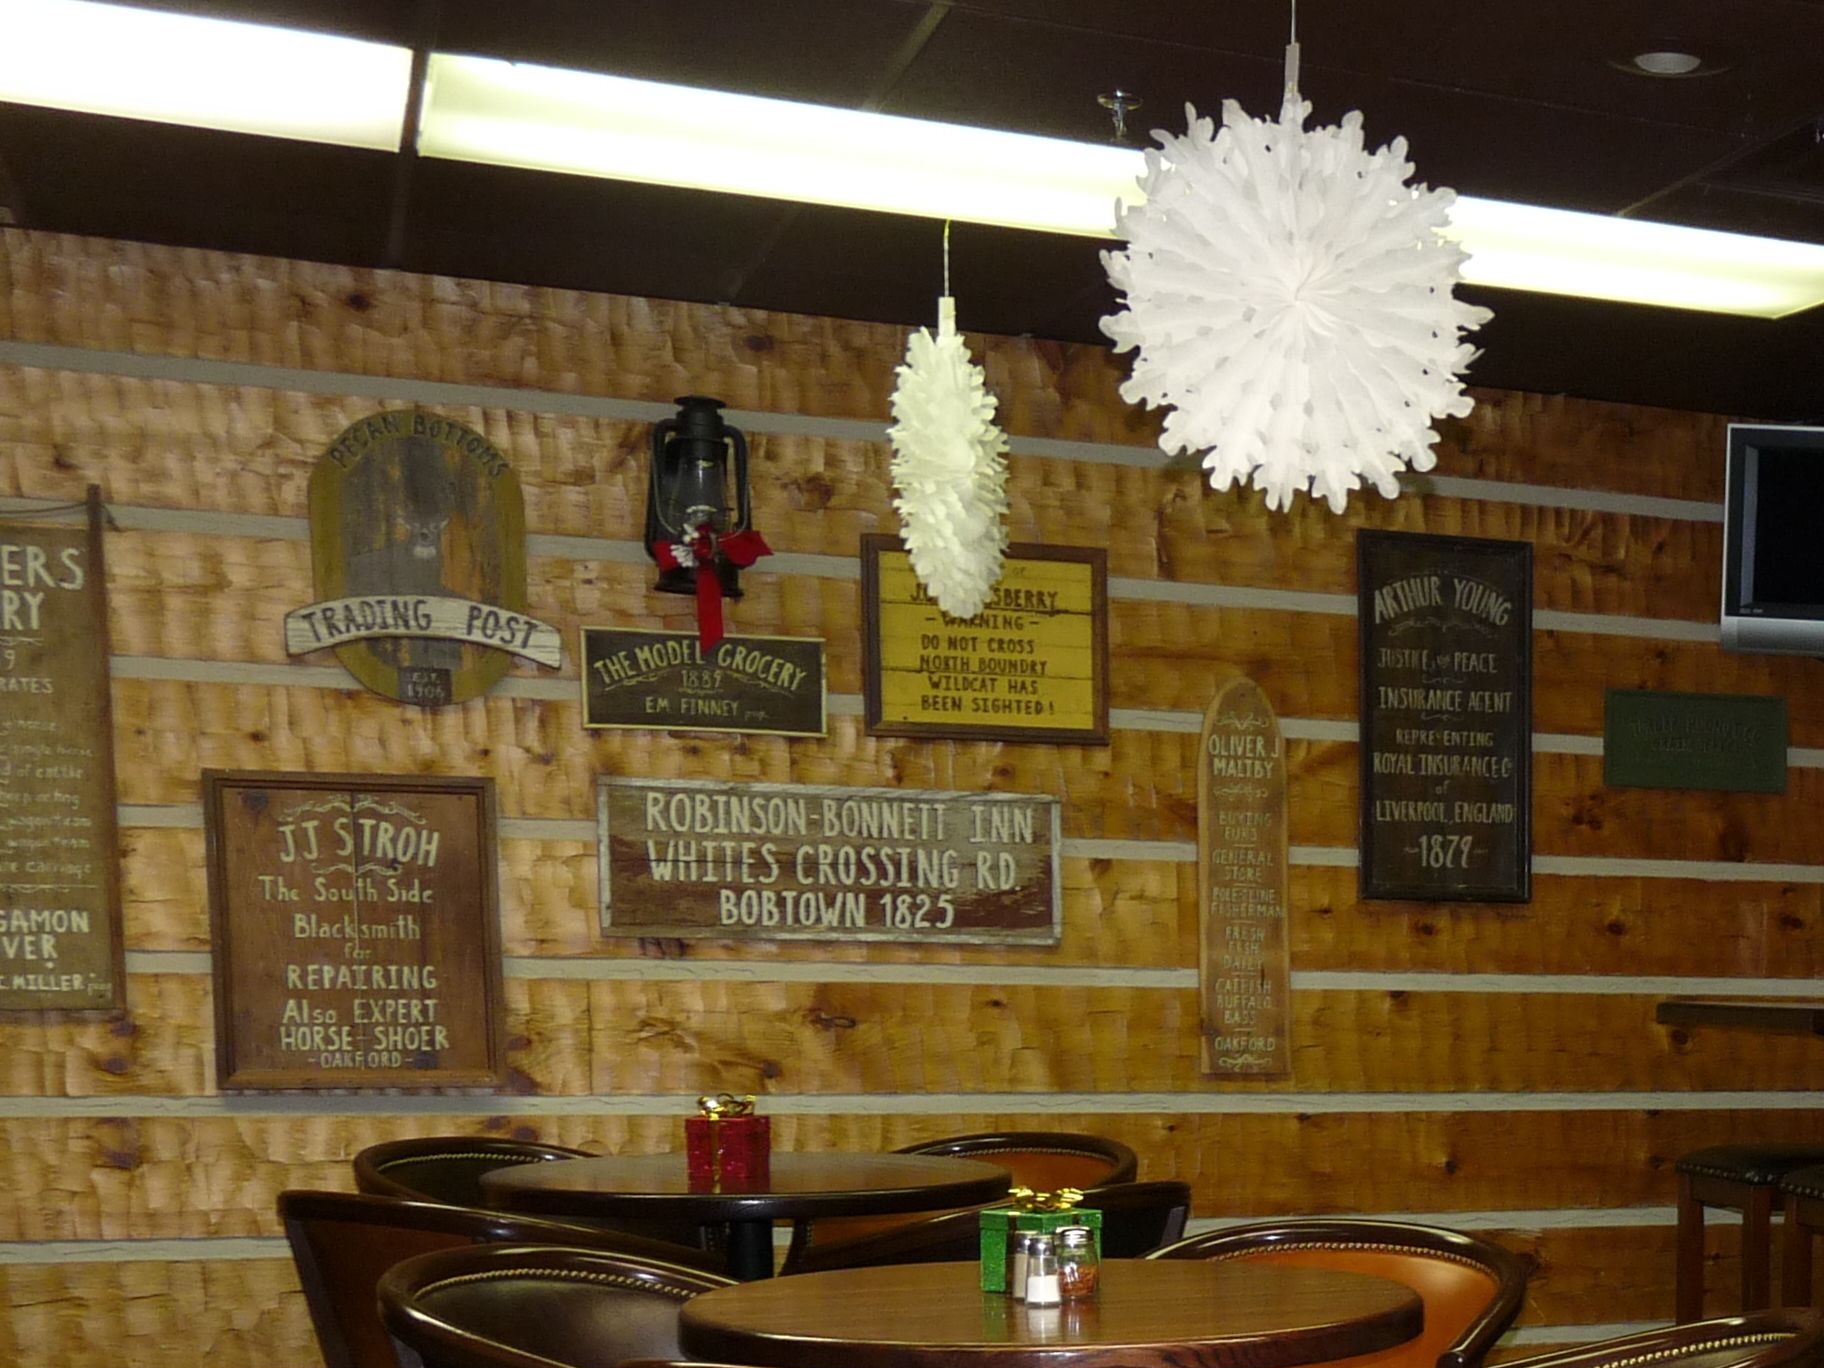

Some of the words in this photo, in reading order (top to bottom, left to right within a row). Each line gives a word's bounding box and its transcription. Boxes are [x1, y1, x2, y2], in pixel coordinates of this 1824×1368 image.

[1374, 576, 1443, 625] ARTHUR
[1453, 578, 1512, 626] YOUNG
[301, 599, 432, 643] TRADING
[465, 605, 539, 650] POST
[921, 633, 940, 650] DO
[946, 636, 979, 652] NOT
[987, 638, 1035, 654] CROSS
[593, 650, 636, 684] THE
[634, 640, 706, 672] MODEL
[717, 643, 807, 692] GROCERY
[919, 655, 969, 673] NORTH
[978, 657, 1048, 676] BOUNDRY
[1453, 652, 1499, 674] PEACE
[928, 676, 998, 693] WILDCAT
[1008, 679, 1038, 695] HAS
[645, 696, 670, 714] EM
[680, 698, 739, 716] FINNEY
[921, 695, 962, 712] BEEN
[1377, 686, 1463, 712] INSURANCE
[1467, 691, 1513, 714] AGENT
[1208, 734, 1266, 758] OLIVER
[1213, 757, 1274, 779] MALTBY
[1372, 752, 1416, 775] ROYAL
[1417, 753, 1499, 778] INSURANCE
[969, 804, 1035, 844] INN
[1454, 801, 1516, 825] ENGLAND
[333, 817, 440, 867] STROH
[645, 840, 780, 883] WHITES
[796, 844, 959, 889] CROSSING
[975, 851, 1021, 891] RD.
[1211, 848, 1274, 866] GENERAL
[1224, 865, 1261, 881] STORE
[258, 875, 300, 901] The
[314, 876, 377, 902] South
[386, 877, 434, 904] Side
[720, 888, 866, 927] BOBTOWN
[880, 894, 955, 929] 1825
[1210, 902, 1284, 919] FISHERMAN
[293, 912, 421, 939] Blacksmith
[12, 973, 85, 992] MILLER
[286, 964, 438, 990] REPAIRING
[1215, 978, 1272, 994] CATFISH
[282, 999, 337, 1024] Also
[353, 999, 439, 1024] EXPERT
[1224, 1010, 1257, 1025] BASS
[1214, 1036, 1276, 1052] OAKFORD
